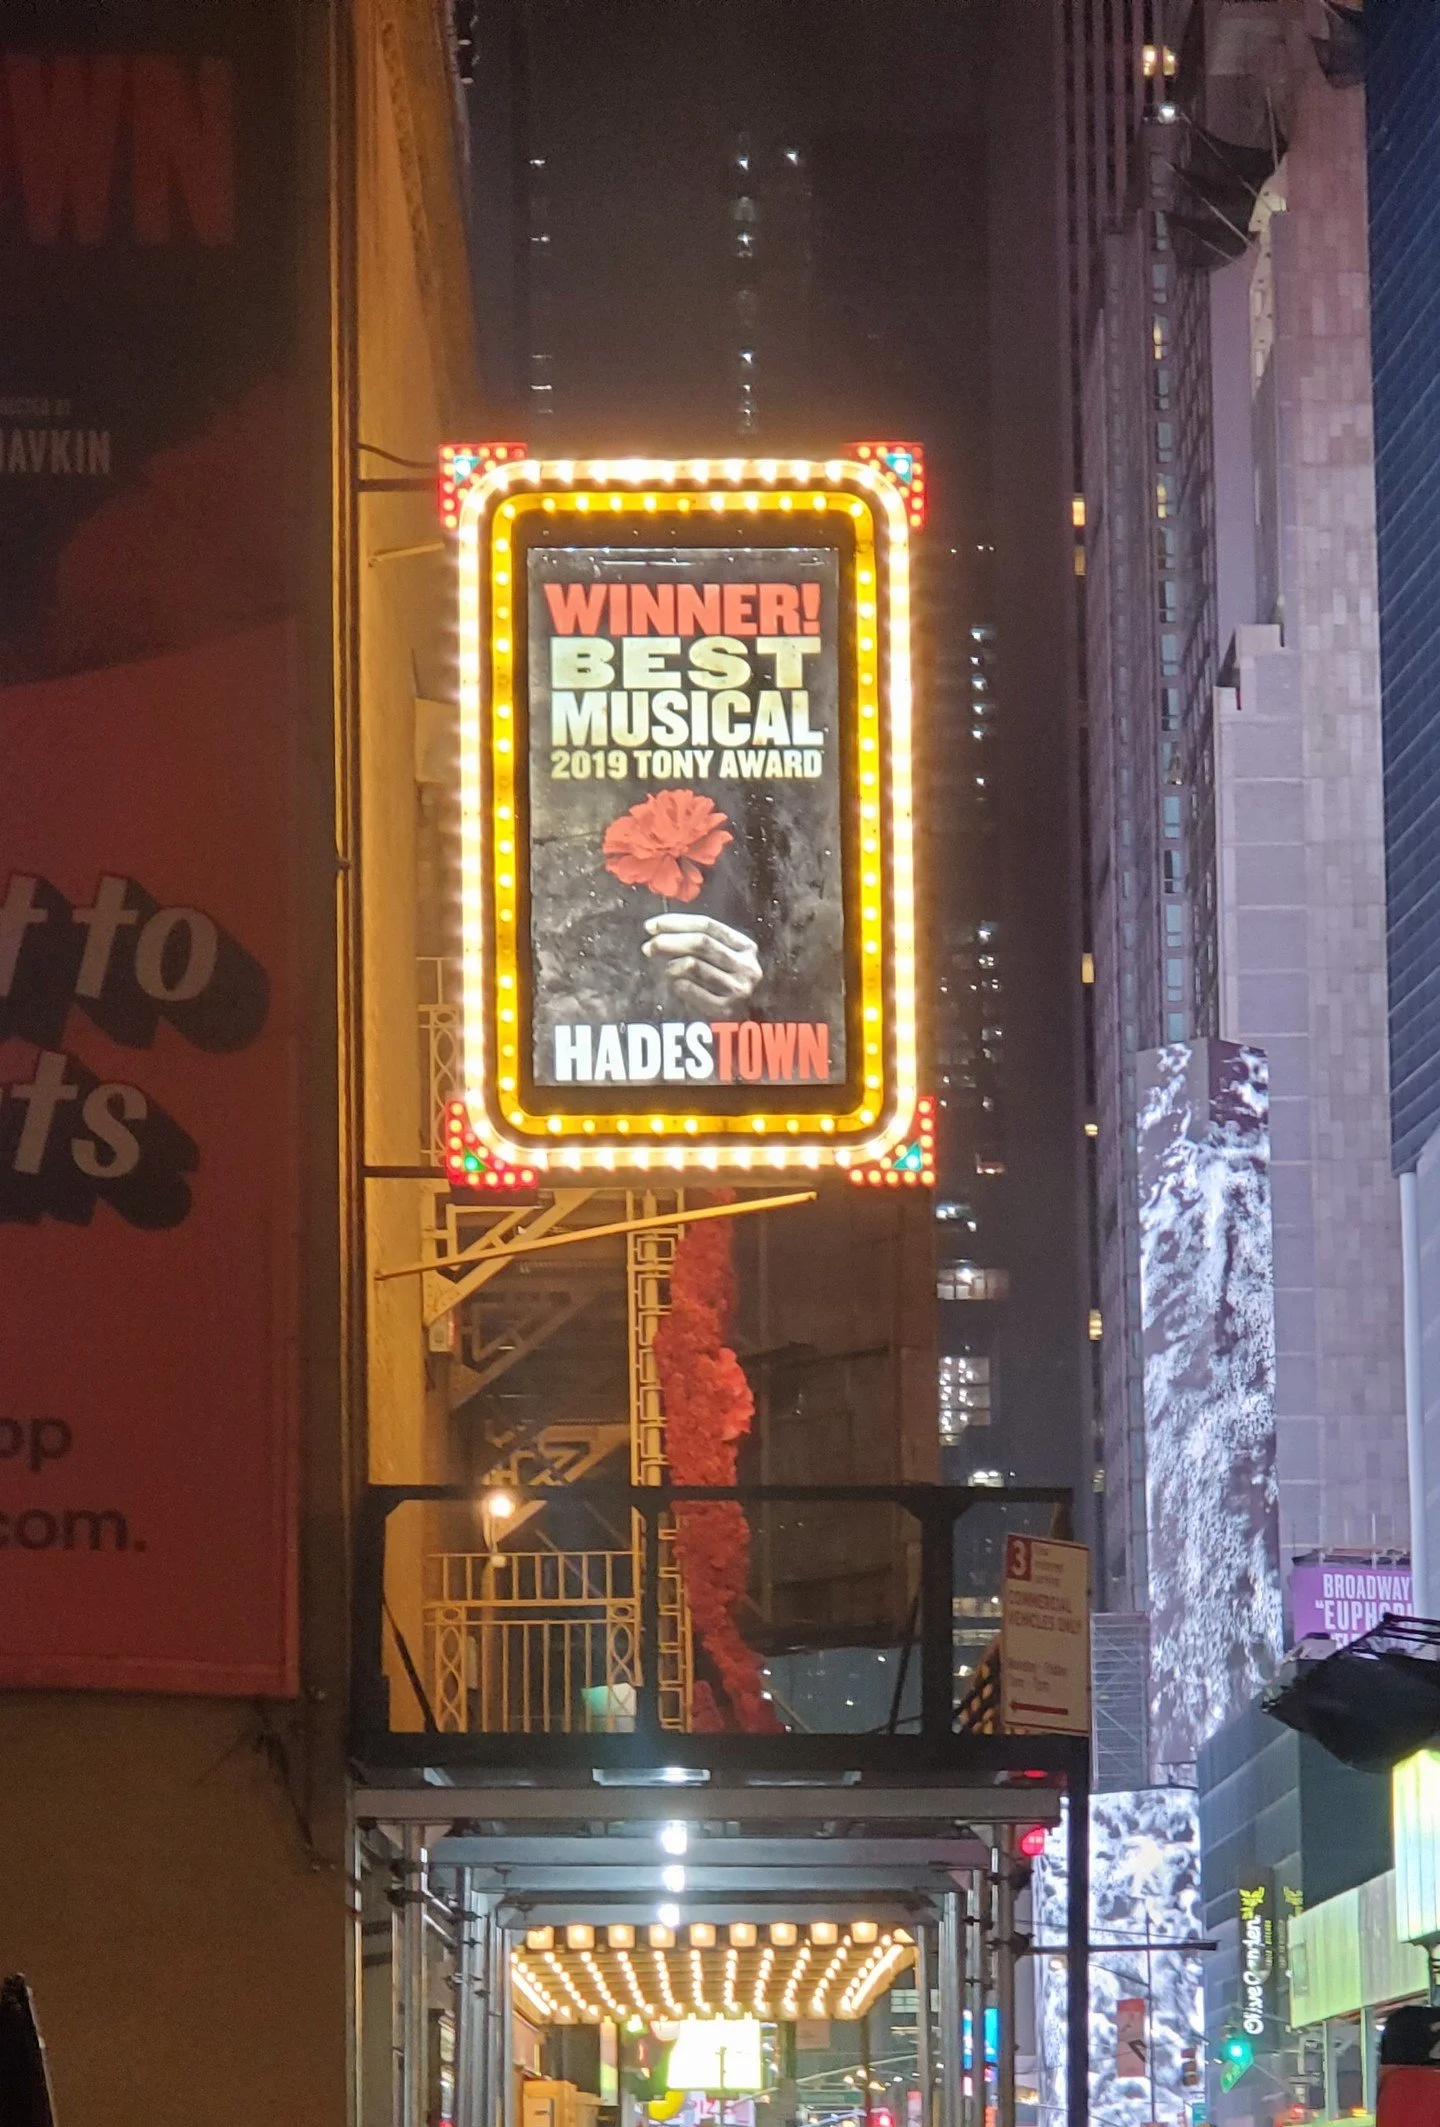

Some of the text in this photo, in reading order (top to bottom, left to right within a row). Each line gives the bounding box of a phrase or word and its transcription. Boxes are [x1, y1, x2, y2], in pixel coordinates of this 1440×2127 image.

[0, 428, 111, 475] AVKIN
[544, 583, 821, 636] WINNER!
[551, 637, 821, 690] BEST
[551, 690, 824, 747] MUSICAL
[550, 750, 823, 780] 2019 TONY AWARD
[72, 875, 219, 1001] to
[554, 1020, 830, 1082] HADESTOWN
[0, 1508, 147, 1552] om.
[1011, 1539, 1027, 1576] 3
[1242, 1986, 1265, 2035] Olive
